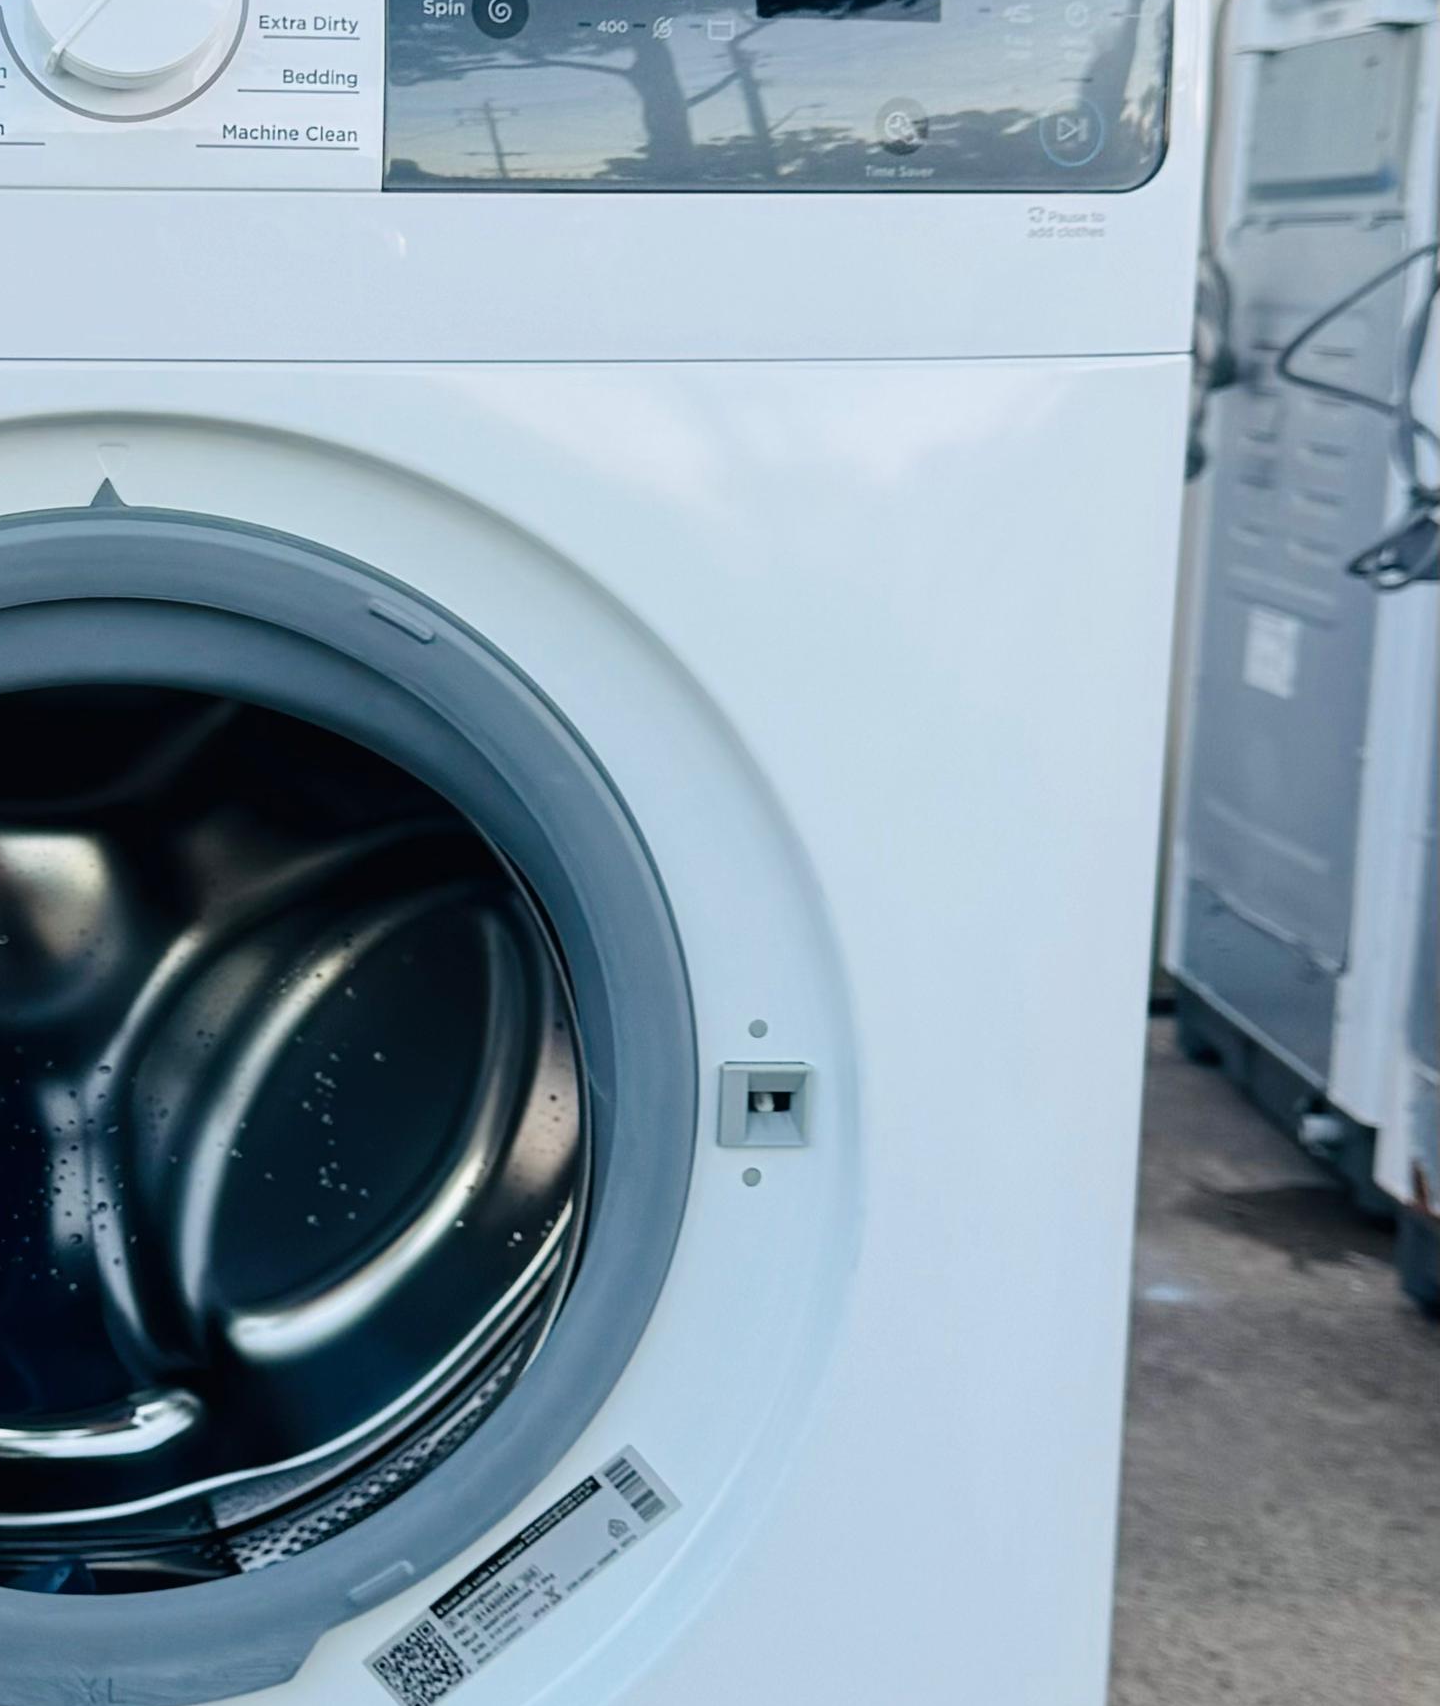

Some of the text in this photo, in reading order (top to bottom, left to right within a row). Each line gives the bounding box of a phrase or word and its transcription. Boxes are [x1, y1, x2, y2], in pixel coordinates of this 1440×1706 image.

[423, 0, 465, 17] Spin
[259, 15, 359, 34] Extra Dirty
[596, 20, 628, 34] 400
[282, 69, 359, 89] Bedding
[222, 124, 358, 142] Machine Clean
